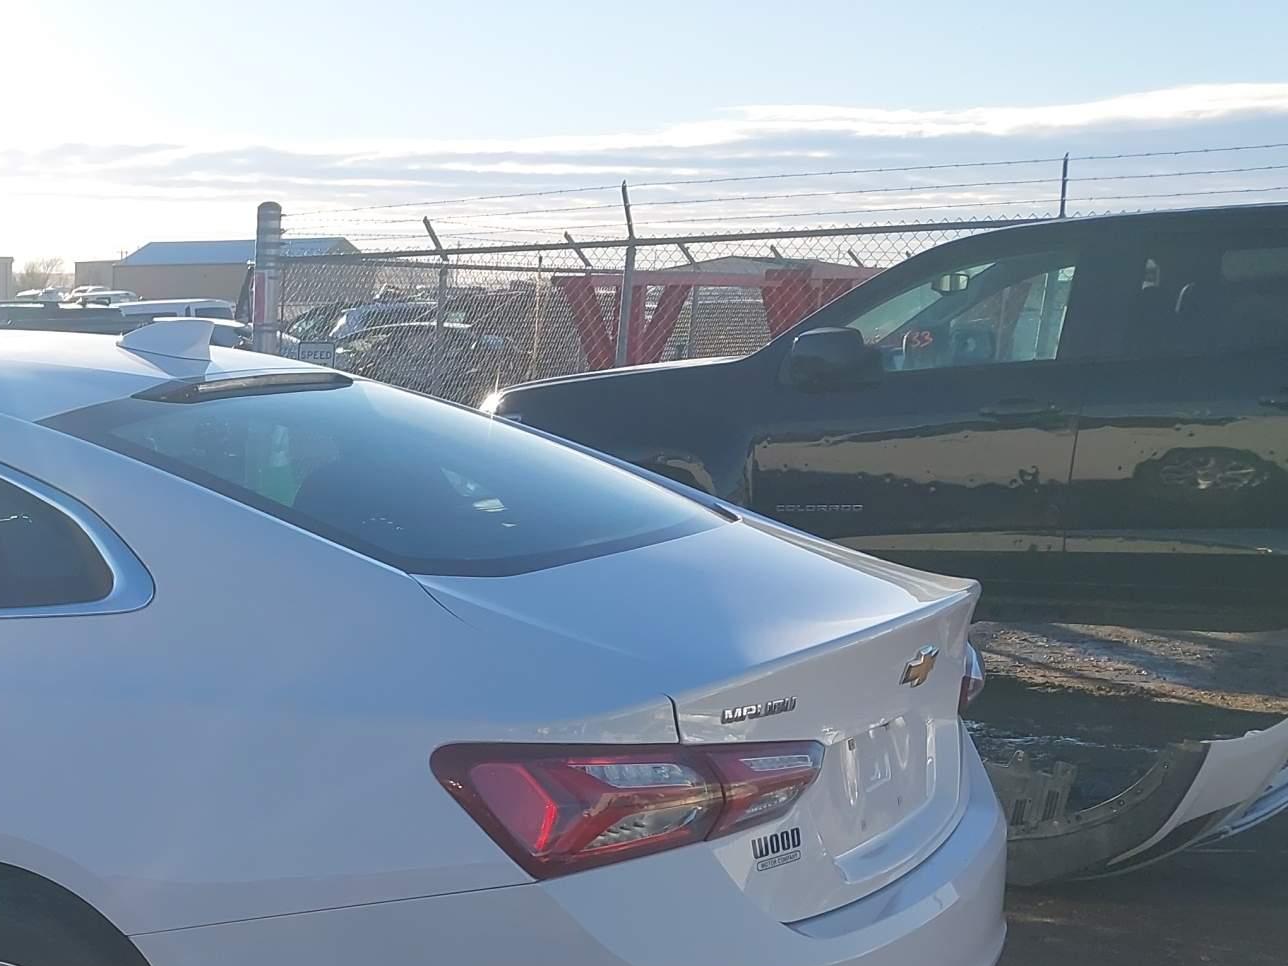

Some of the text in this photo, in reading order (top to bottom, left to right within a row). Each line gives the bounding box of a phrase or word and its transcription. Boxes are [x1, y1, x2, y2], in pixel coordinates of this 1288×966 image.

[300, 350, 332, 360] SPEED
[775, 504, 864, 513] COLORADO
[751, 827, 801, 859] WOOD
